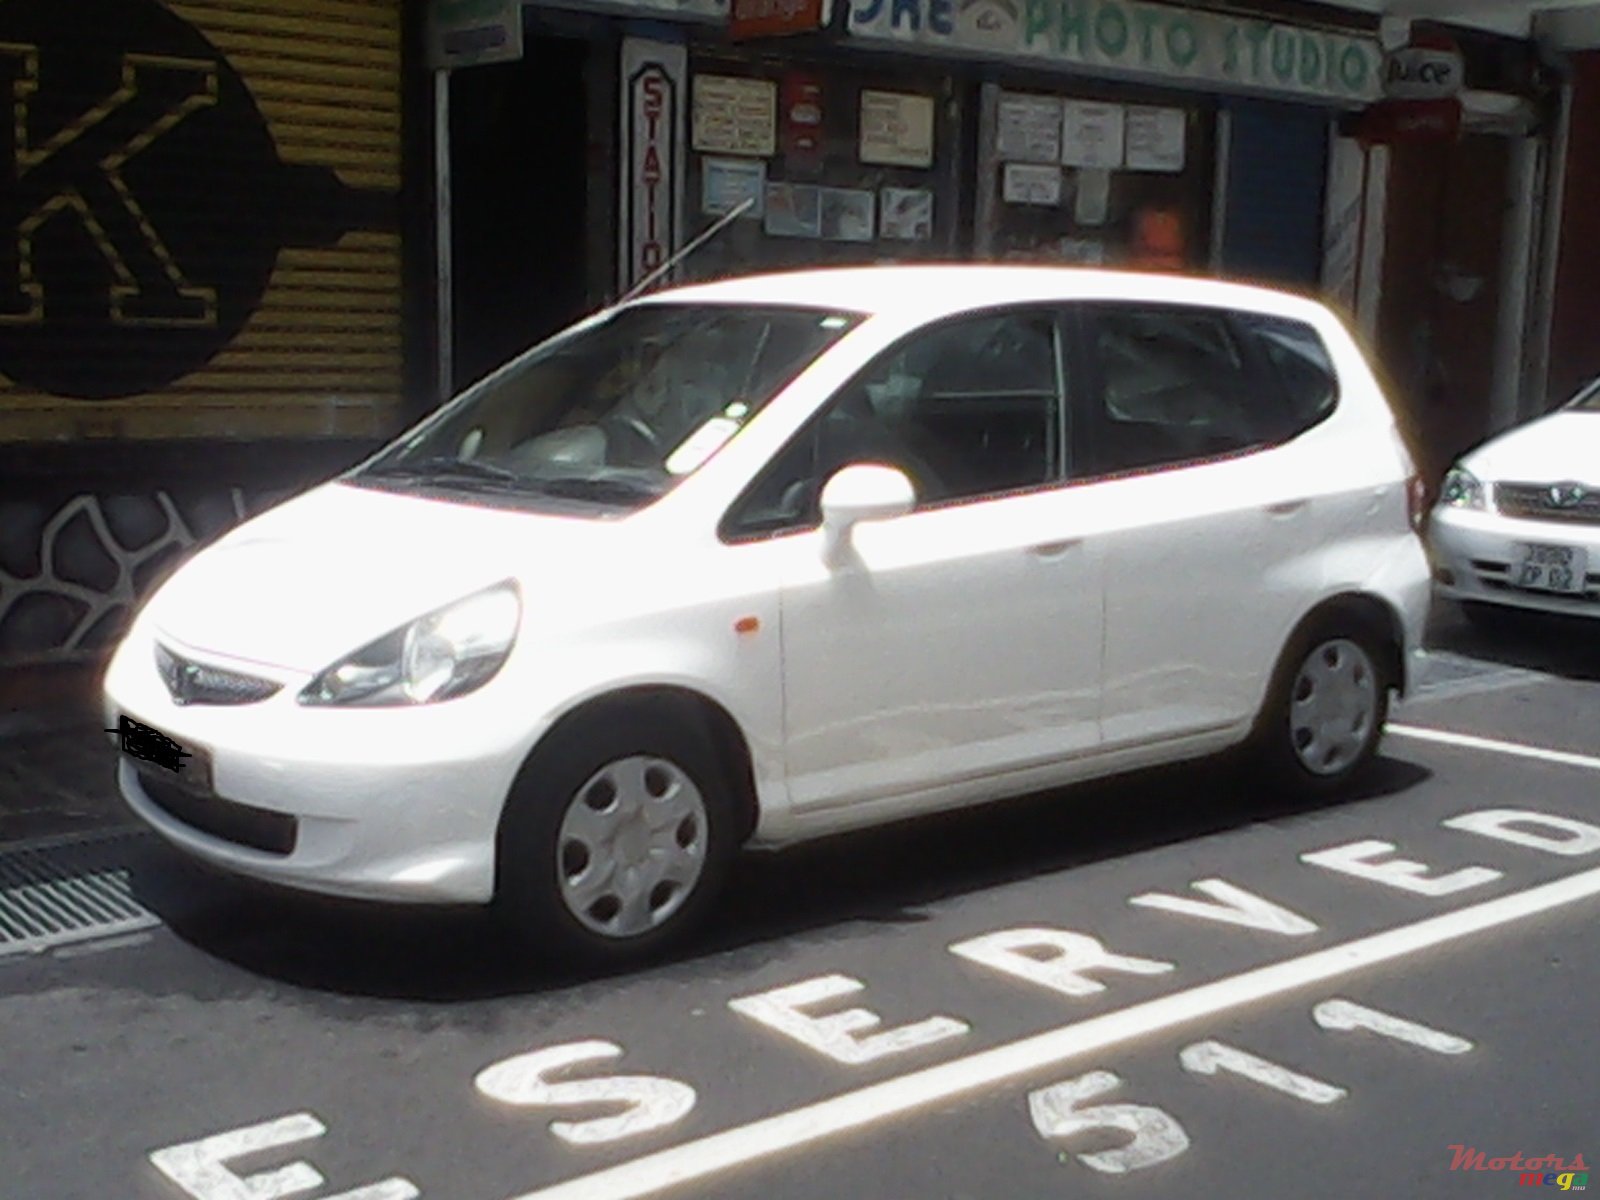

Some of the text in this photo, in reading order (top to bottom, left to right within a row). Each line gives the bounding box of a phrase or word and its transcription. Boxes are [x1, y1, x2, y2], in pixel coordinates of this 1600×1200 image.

[1025, 0, 1196, 66] PHOTO
[1222, 21, 1367, 89] STUDIO
[0, 42, 218, 327] K
[642, 76, 661, 270] STATIO
[1028, 1000, 1474, 1173] 511
